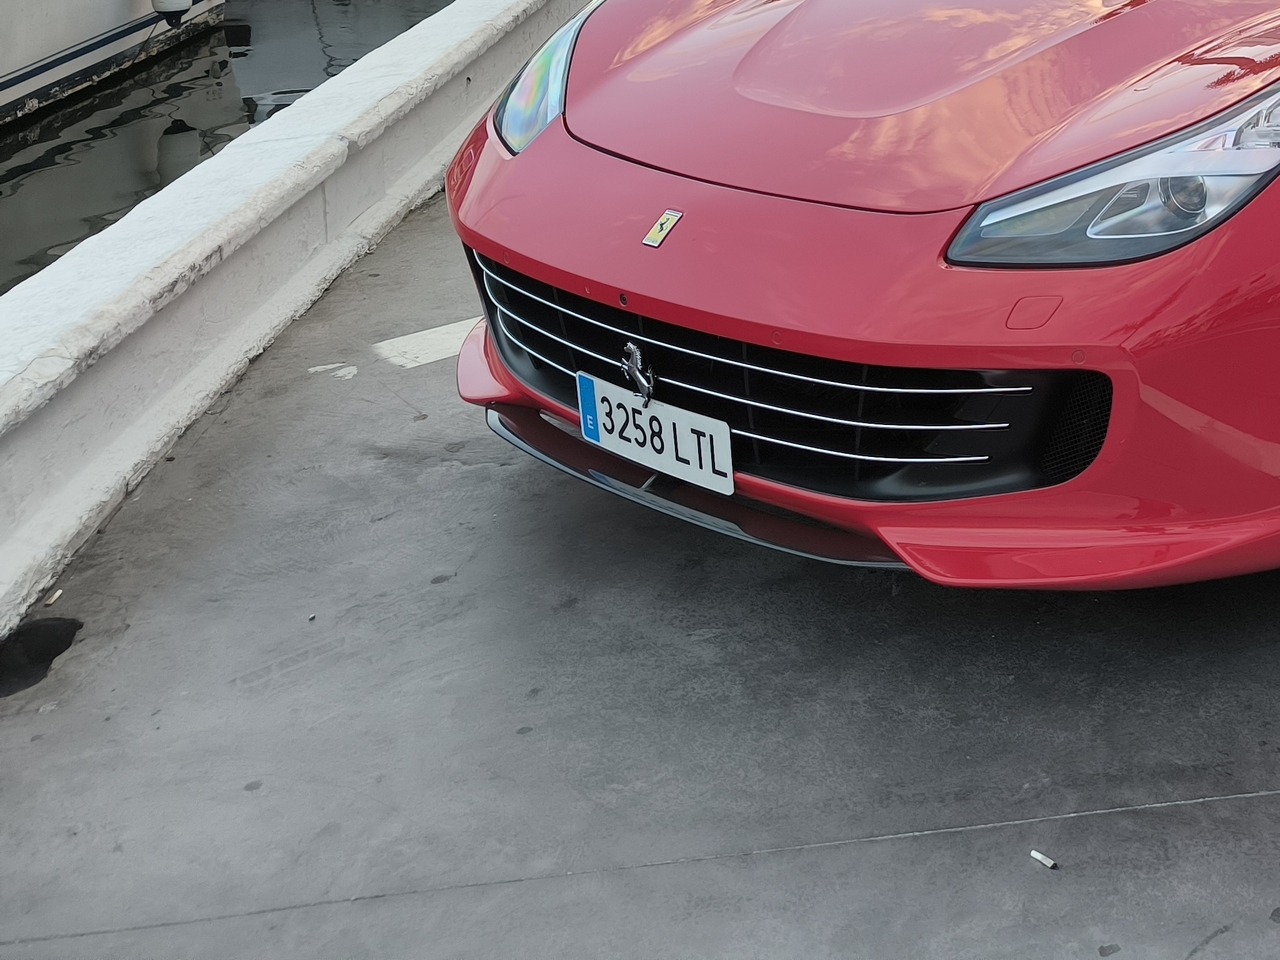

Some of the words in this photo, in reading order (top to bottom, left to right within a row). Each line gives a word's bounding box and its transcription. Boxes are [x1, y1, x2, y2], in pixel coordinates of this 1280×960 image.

[586, 414, 594, 430] E
[600, 396, 665, 454] 3258
[672, 422, 728, 478] LTL
